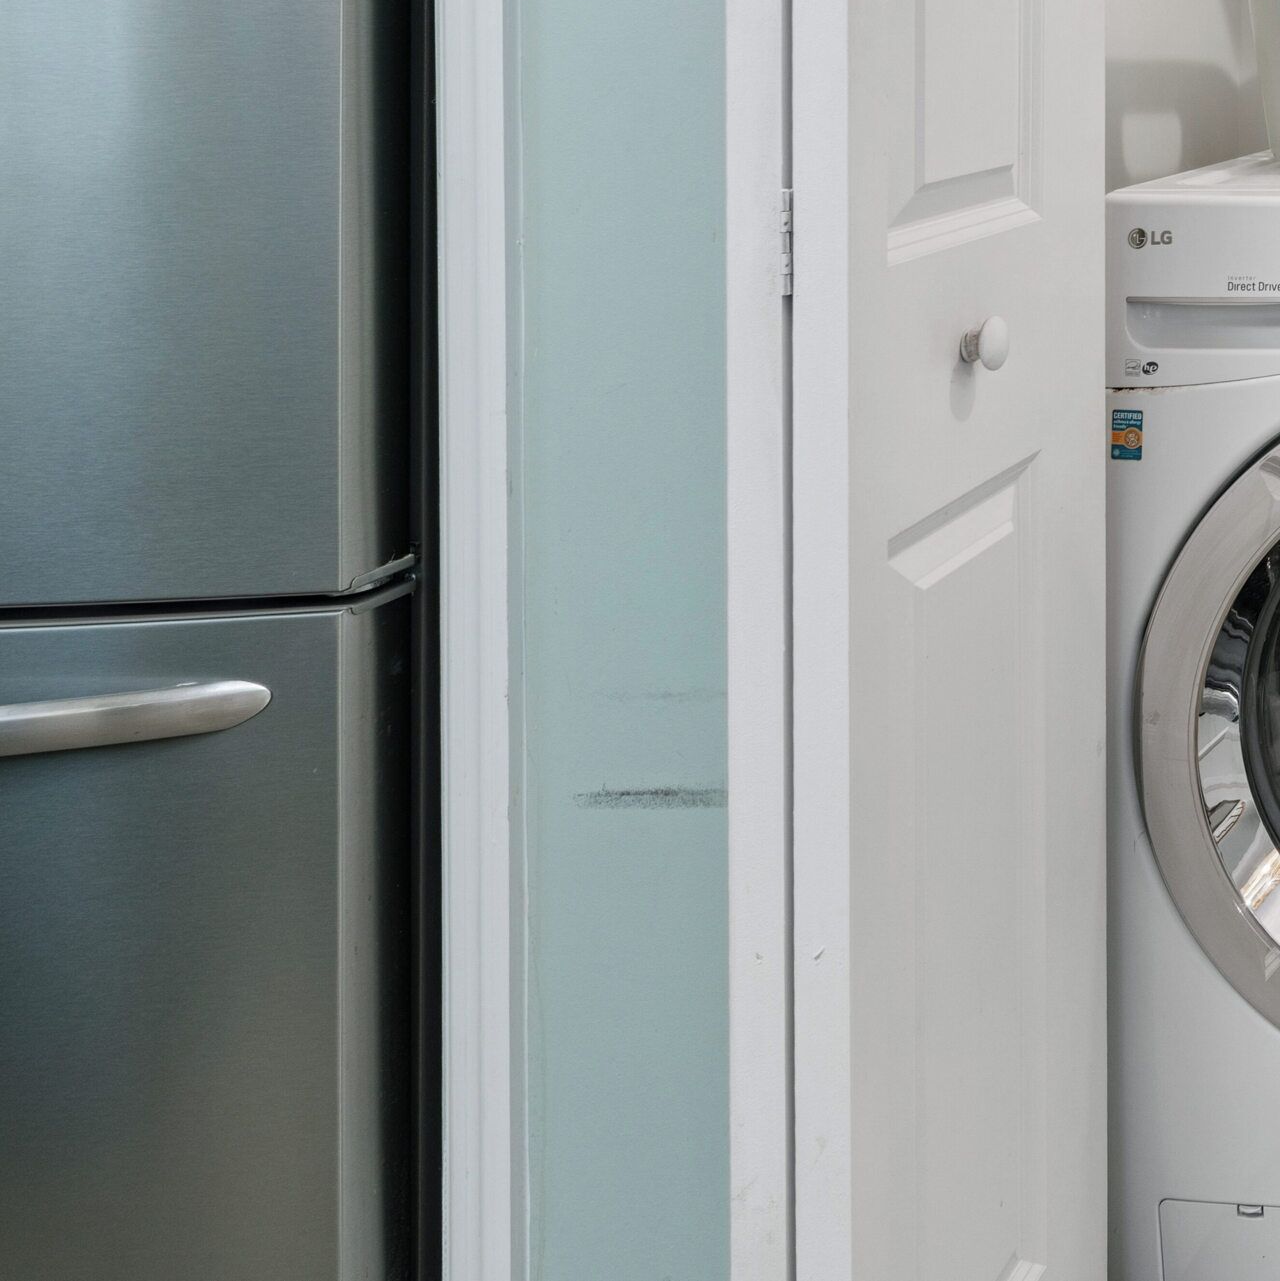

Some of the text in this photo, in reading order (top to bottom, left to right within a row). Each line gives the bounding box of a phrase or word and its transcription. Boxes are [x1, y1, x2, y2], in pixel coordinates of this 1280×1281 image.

[1150, 230, 1173, 245] LG
[1227, 281, 1256, 292] Direct
[1113, 412, 1142, 420] CERTIFIED
